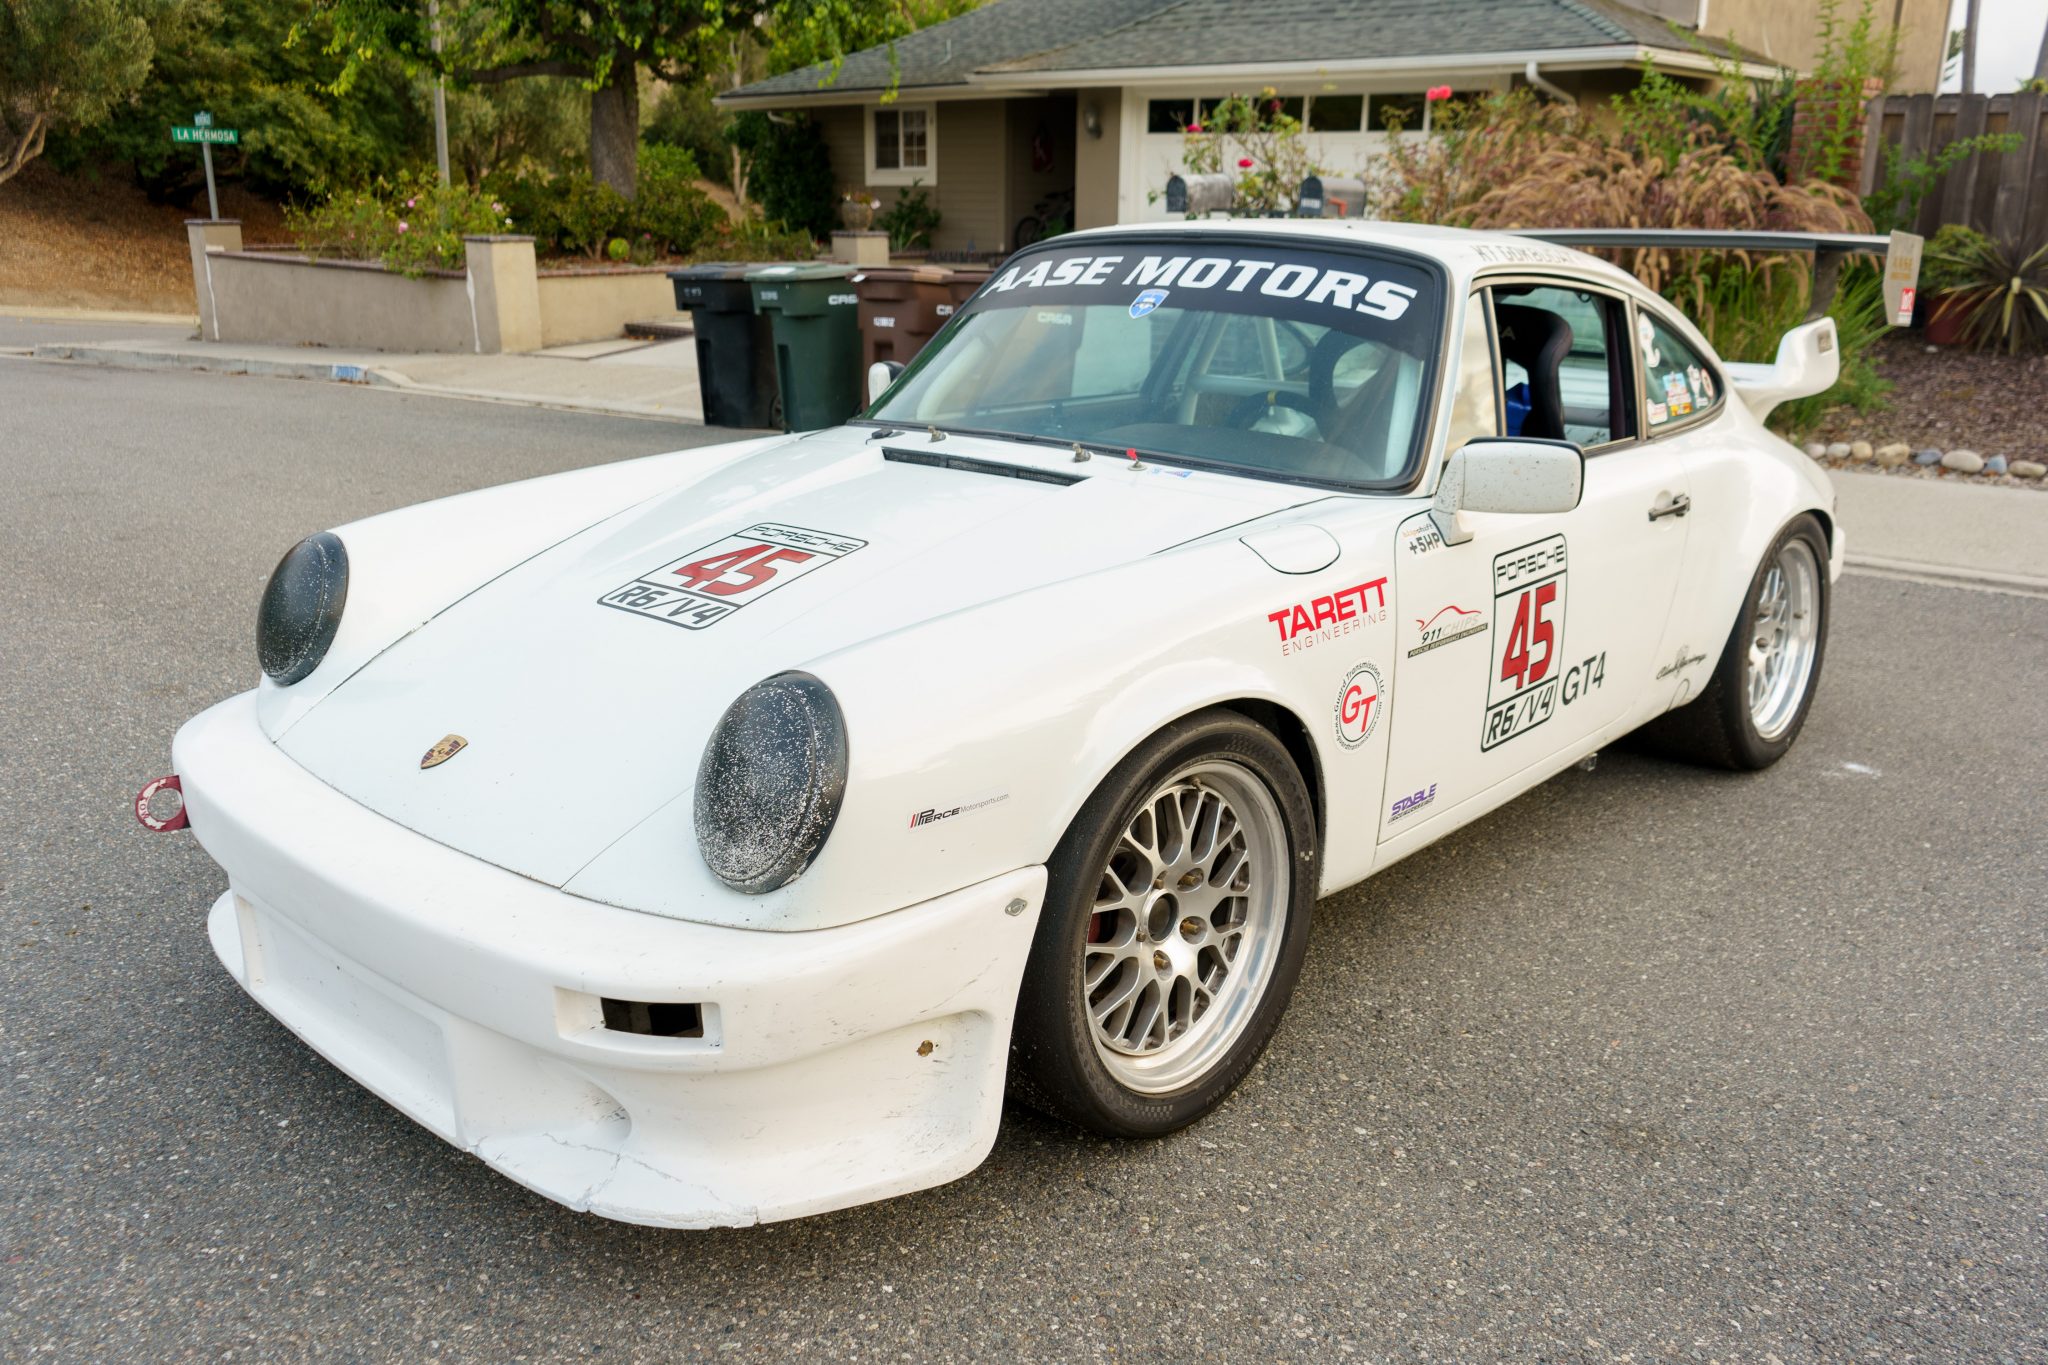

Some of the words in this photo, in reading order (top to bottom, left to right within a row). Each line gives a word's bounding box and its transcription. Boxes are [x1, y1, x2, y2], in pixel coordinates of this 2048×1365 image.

[177, 128, 189, 141] LA
[192, 129, 235, 142] HERMOSA
[980, 255, 1124, 298] AASE
[1122, 256, 1418, 321] MOTORS
[752, 526, 860, 552] PORSCHE
[1409, 532, 1441, 555] +5HP
[672, 543, 816, 596] 45
[1497, 544, 1565, 585] PORSCHE
[608, 585, 730, 625] R6/V4
[1267, 576, 1388, 641] TARETT
[1282, 609, 1387, 657] ENGINEERING
[1500, 580, 1557, 691] 45
[1562, 651, 1607, 706] GT4
[1341, 684, 1377, 734] GT
[1486, 685, 1554, 745] R6/V4
[1391, 783, 1438, 817] STABLE
